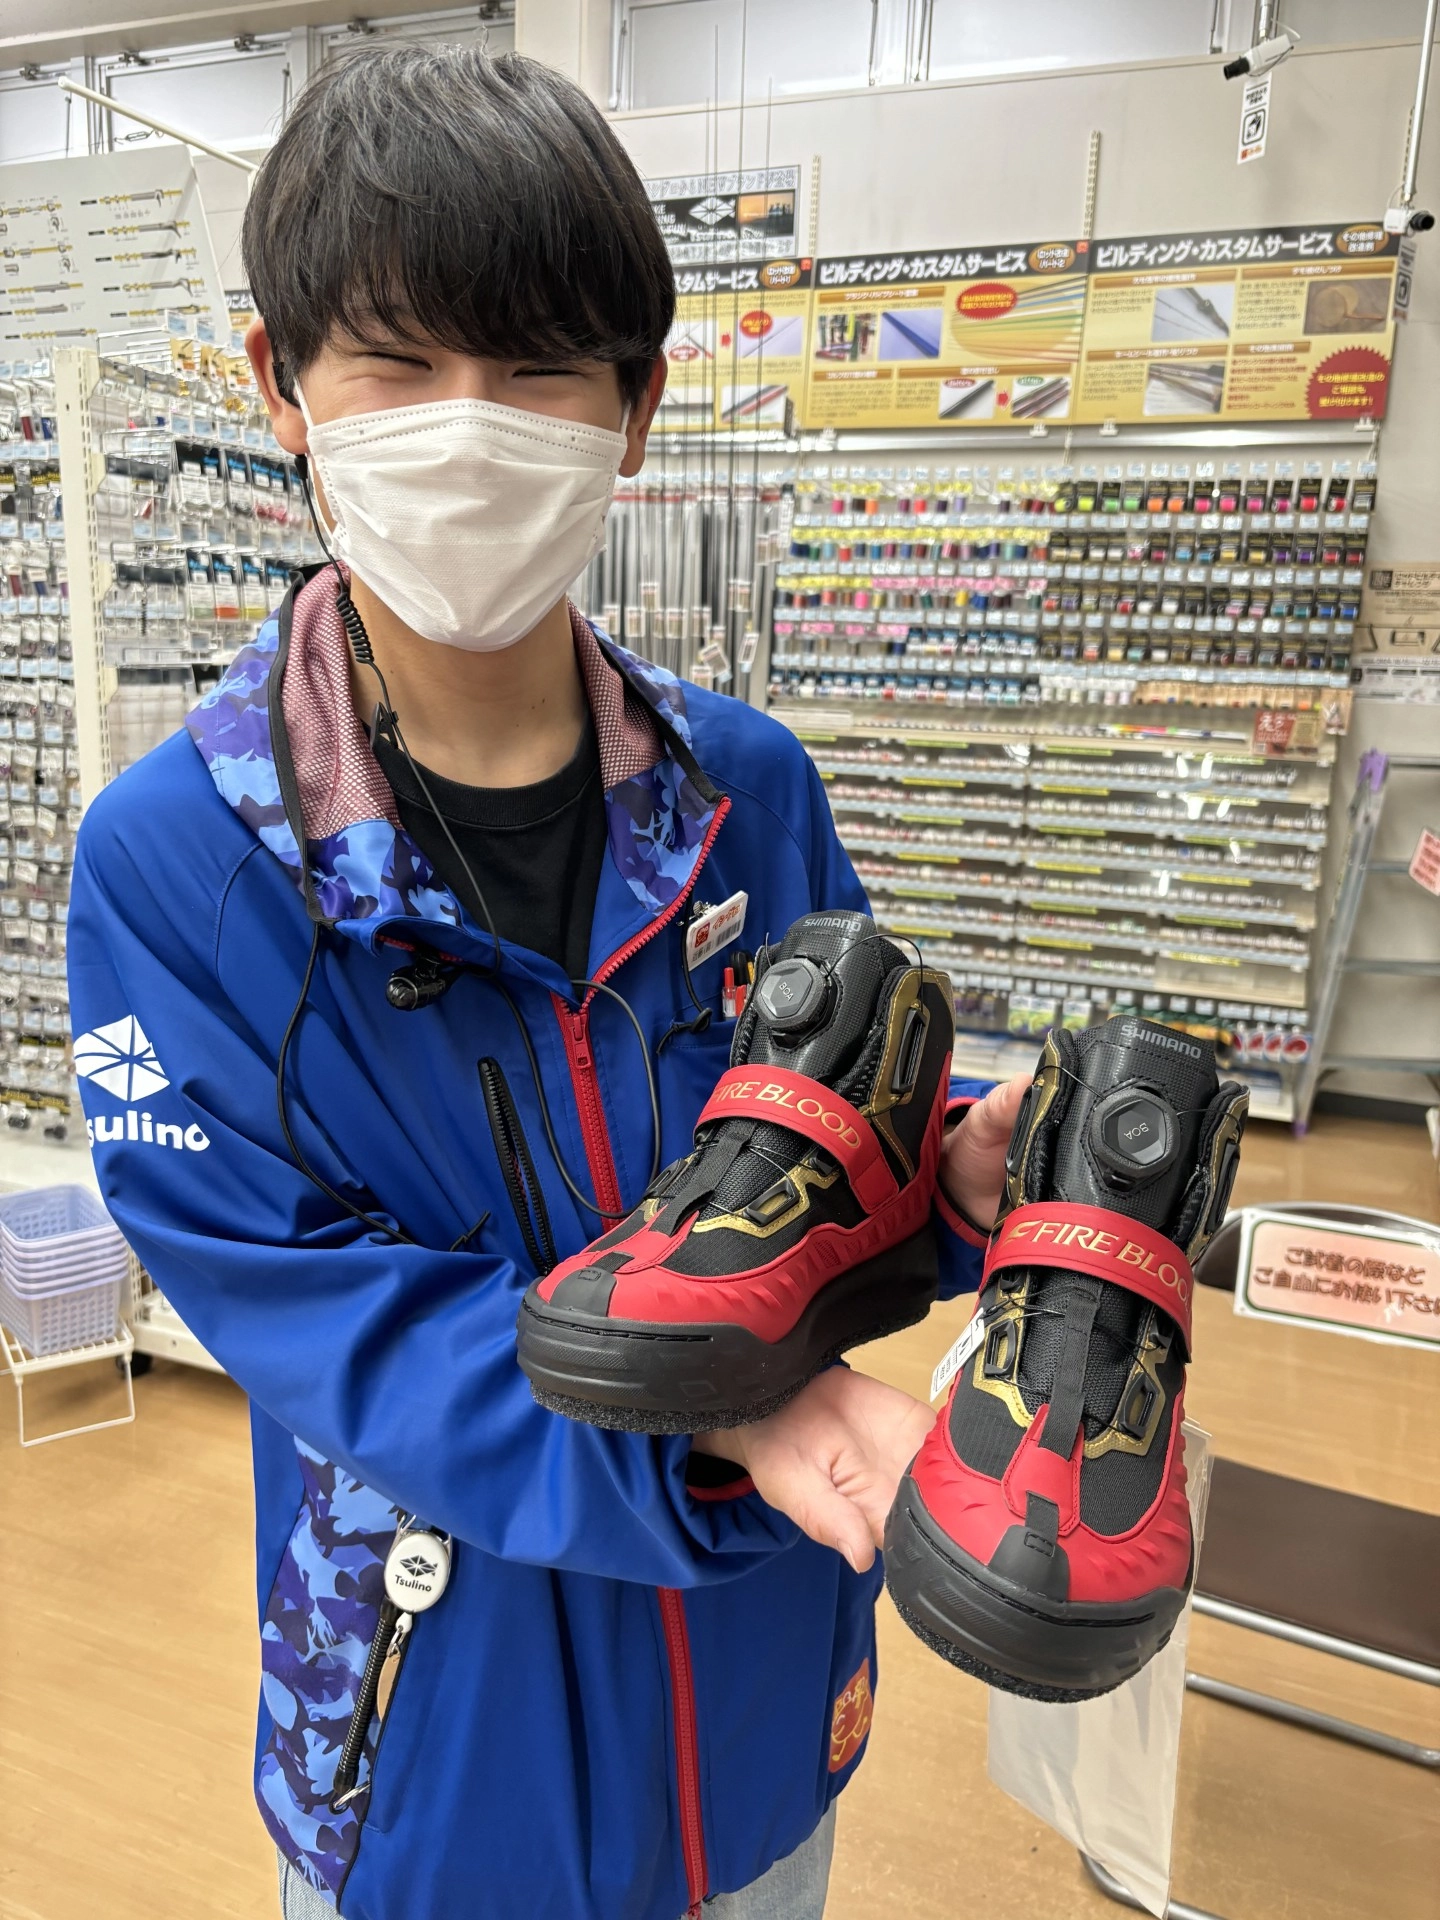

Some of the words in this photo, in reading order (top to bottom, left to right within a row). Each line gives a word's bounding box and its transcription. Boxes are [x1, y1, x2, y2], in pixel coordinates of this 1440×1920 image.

[820, 250, 1027, 285] ビルディング・カスタムサービス
[1096, 232, 1334, 268] ビルディング・カスタムサービス
[803, 917, 862, 933] SHIMANO
[778, 982, 794, 1001] BOA
[1121, 1024, 1202, 1059] SHIMANO
[756, 1083, 861, 1149] BLOOD
[1123, 1122, 1150, 1140] BOA
[1031, 1222, 1120, 1254] FIRE
[1115, 1241, 1190, 1312] BLOO
[394, 1574, 432, 1592] Tsulino
